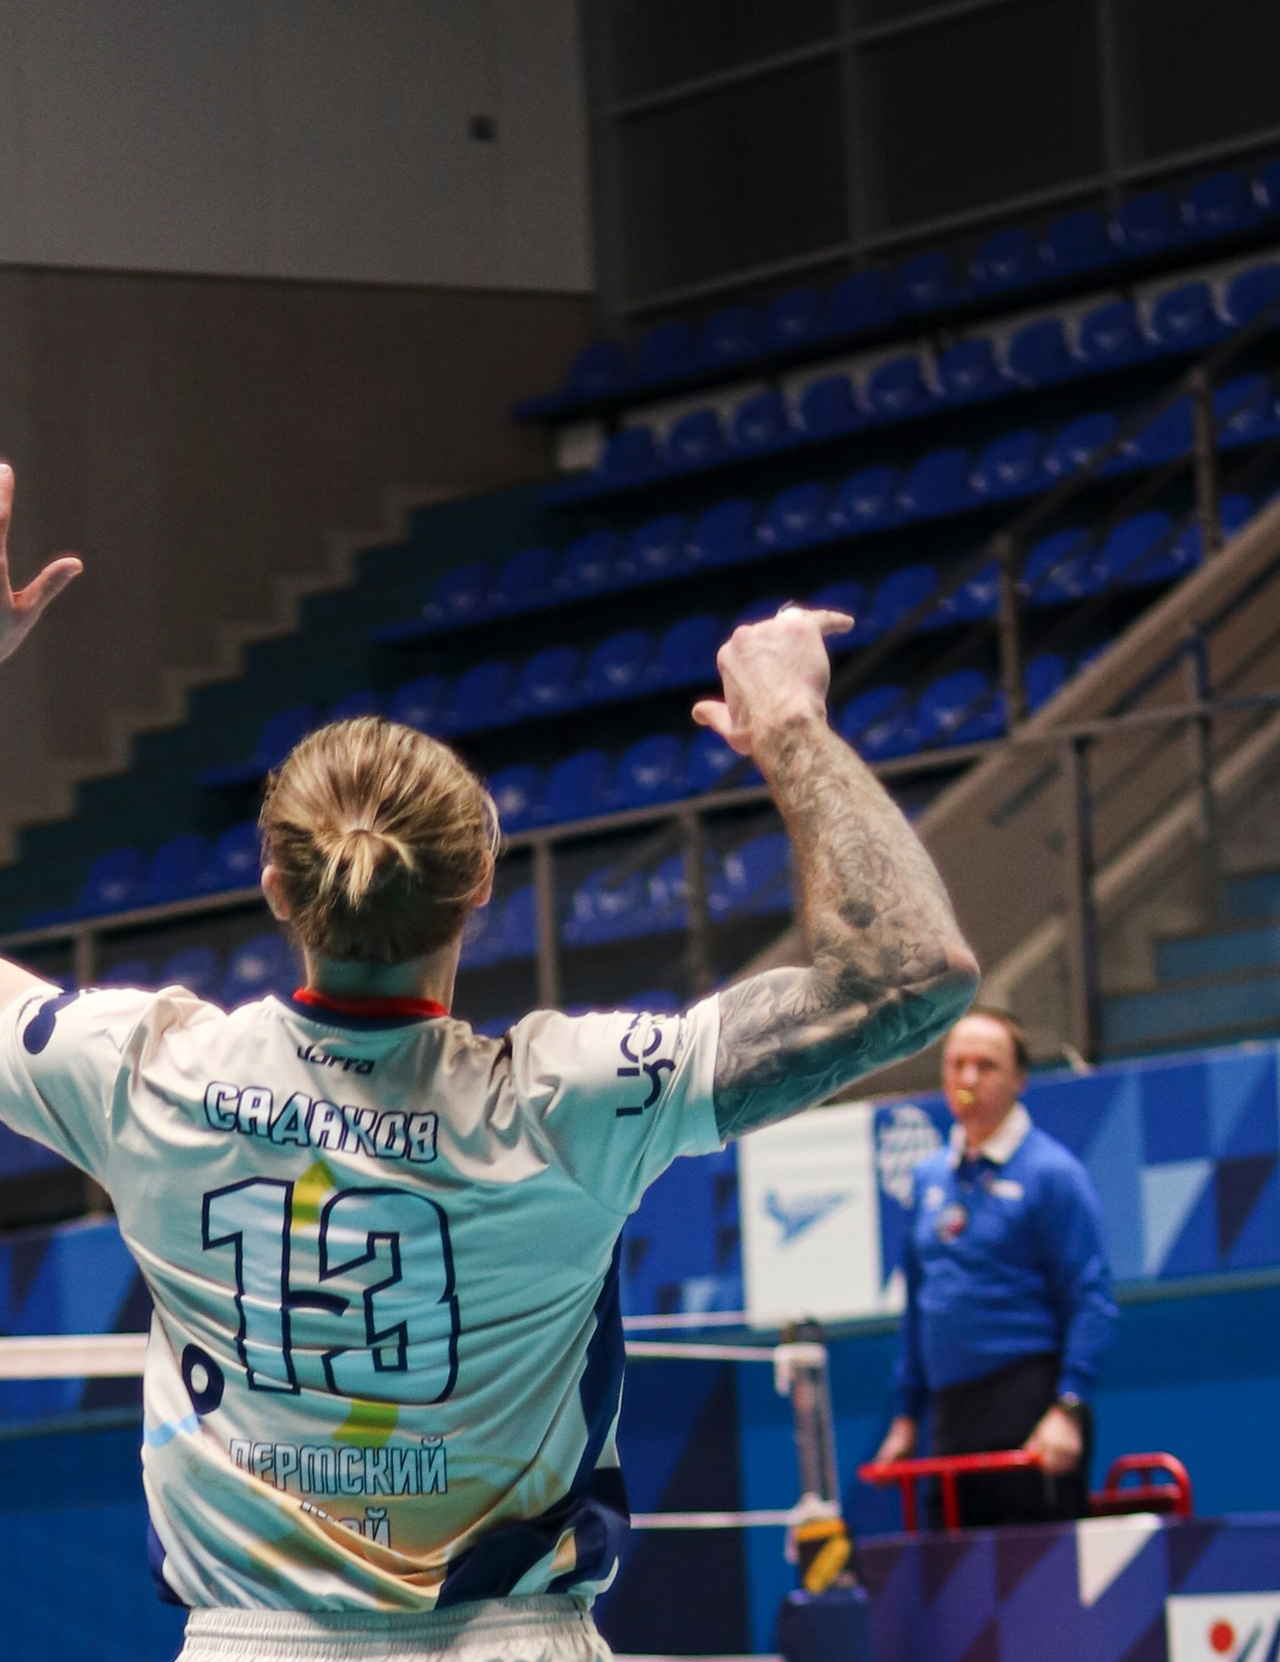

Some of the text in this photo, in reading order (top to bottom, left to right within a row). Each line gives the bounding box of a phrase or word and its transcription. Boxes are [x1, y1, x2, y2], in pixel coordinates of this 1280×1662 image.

[204, 1081, 438, 1163] САДАКОВ
[202, 1176, 460, 1405] 13
[230, 1436, 448, 1496] ПЕРМСКИЙ
